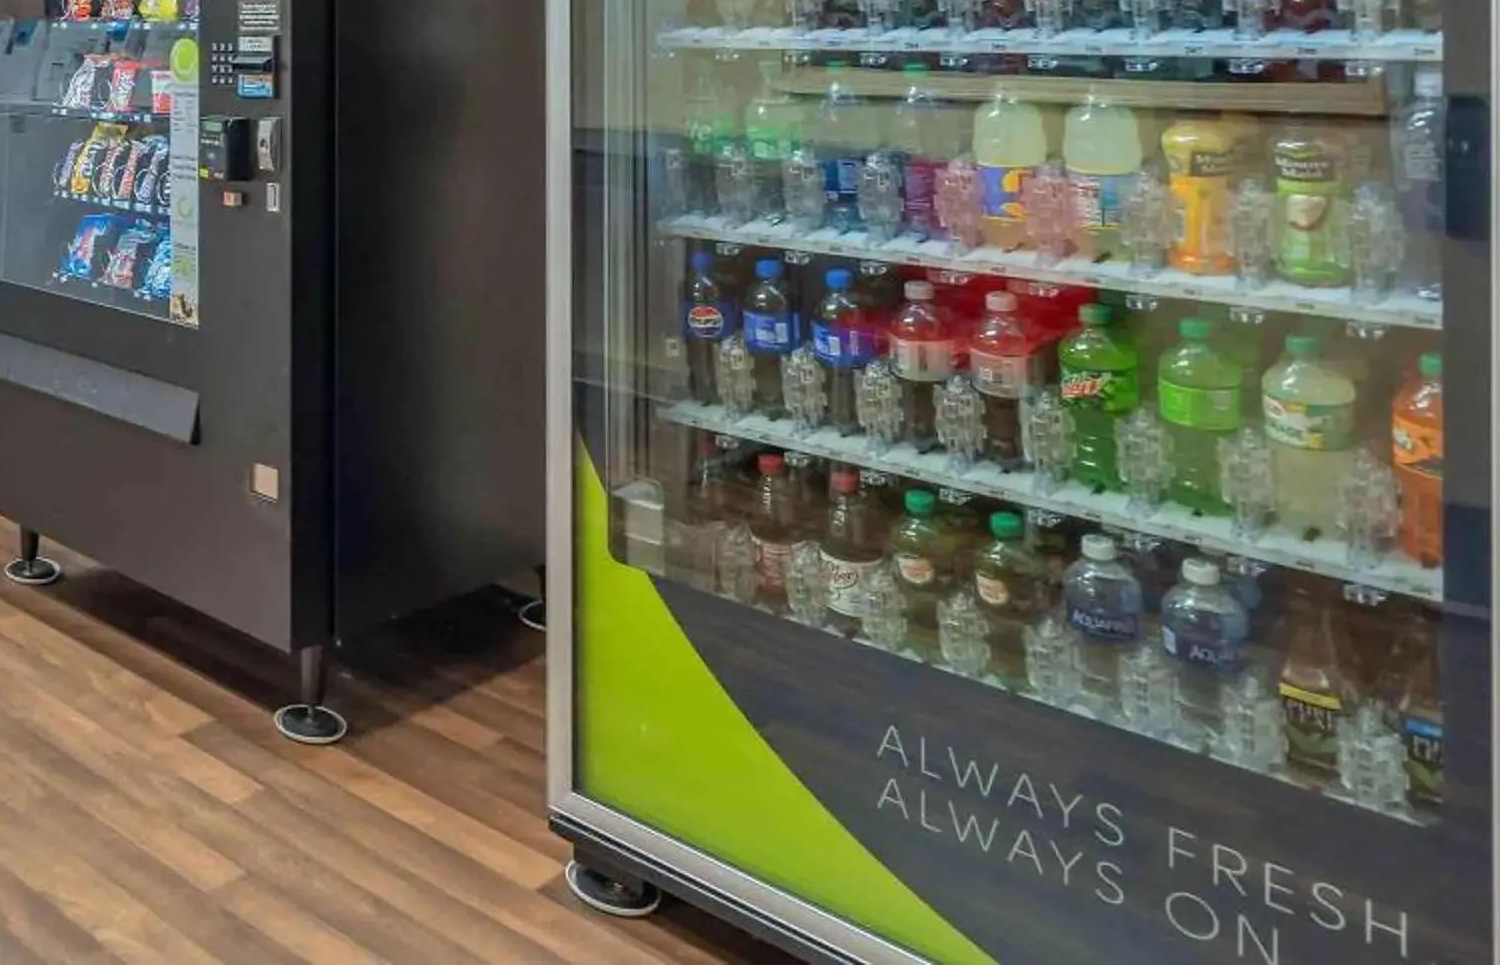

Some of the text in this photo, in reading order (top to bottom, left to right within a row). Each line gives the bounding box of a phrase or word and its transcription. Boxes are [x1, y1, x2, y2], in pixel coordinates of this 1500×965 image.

[876, 724, 1409, 958] ALWAYS FRESH
[876, 778, 1280, 965] ALWAYS ON
